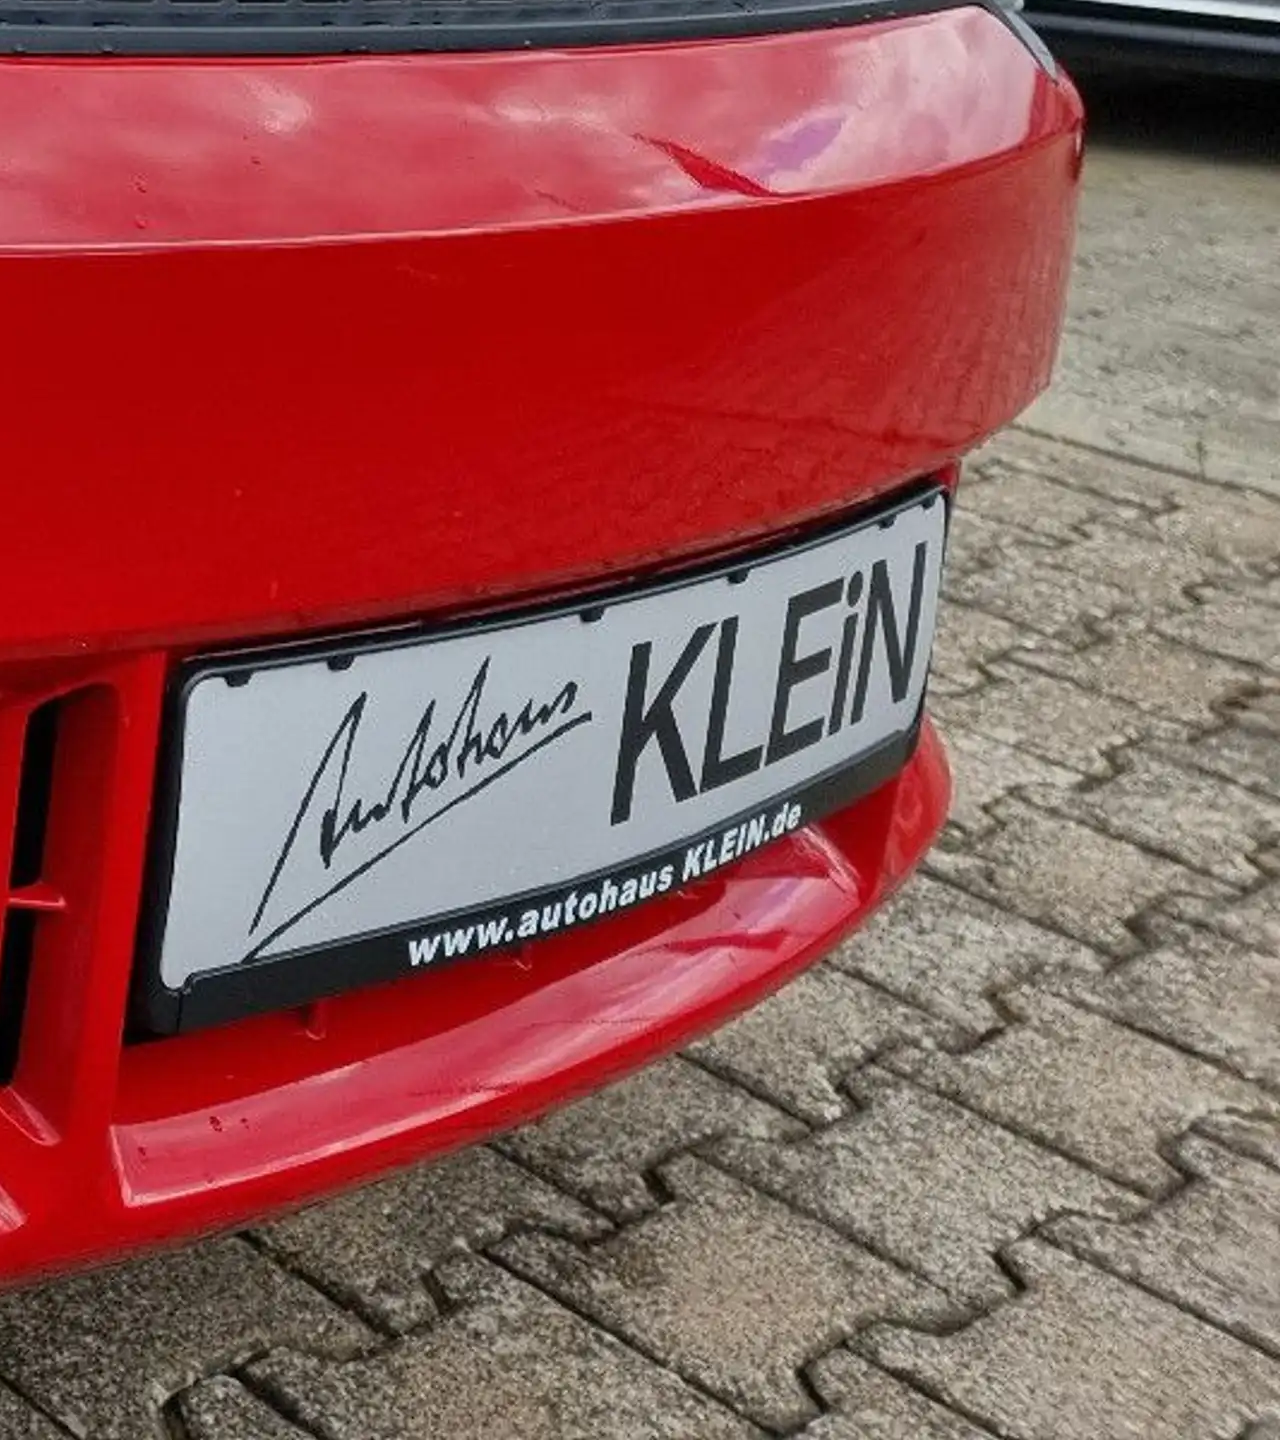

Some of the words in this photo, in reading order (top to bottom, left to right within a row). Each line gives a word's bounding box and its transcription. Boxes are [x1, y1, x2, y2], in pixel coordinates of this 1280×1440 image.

[249, 655, 580, 938] Autohaus
[408, 865, 674, 966] www.autohaus
[682, 802, 802, 882] KLEIN.de
